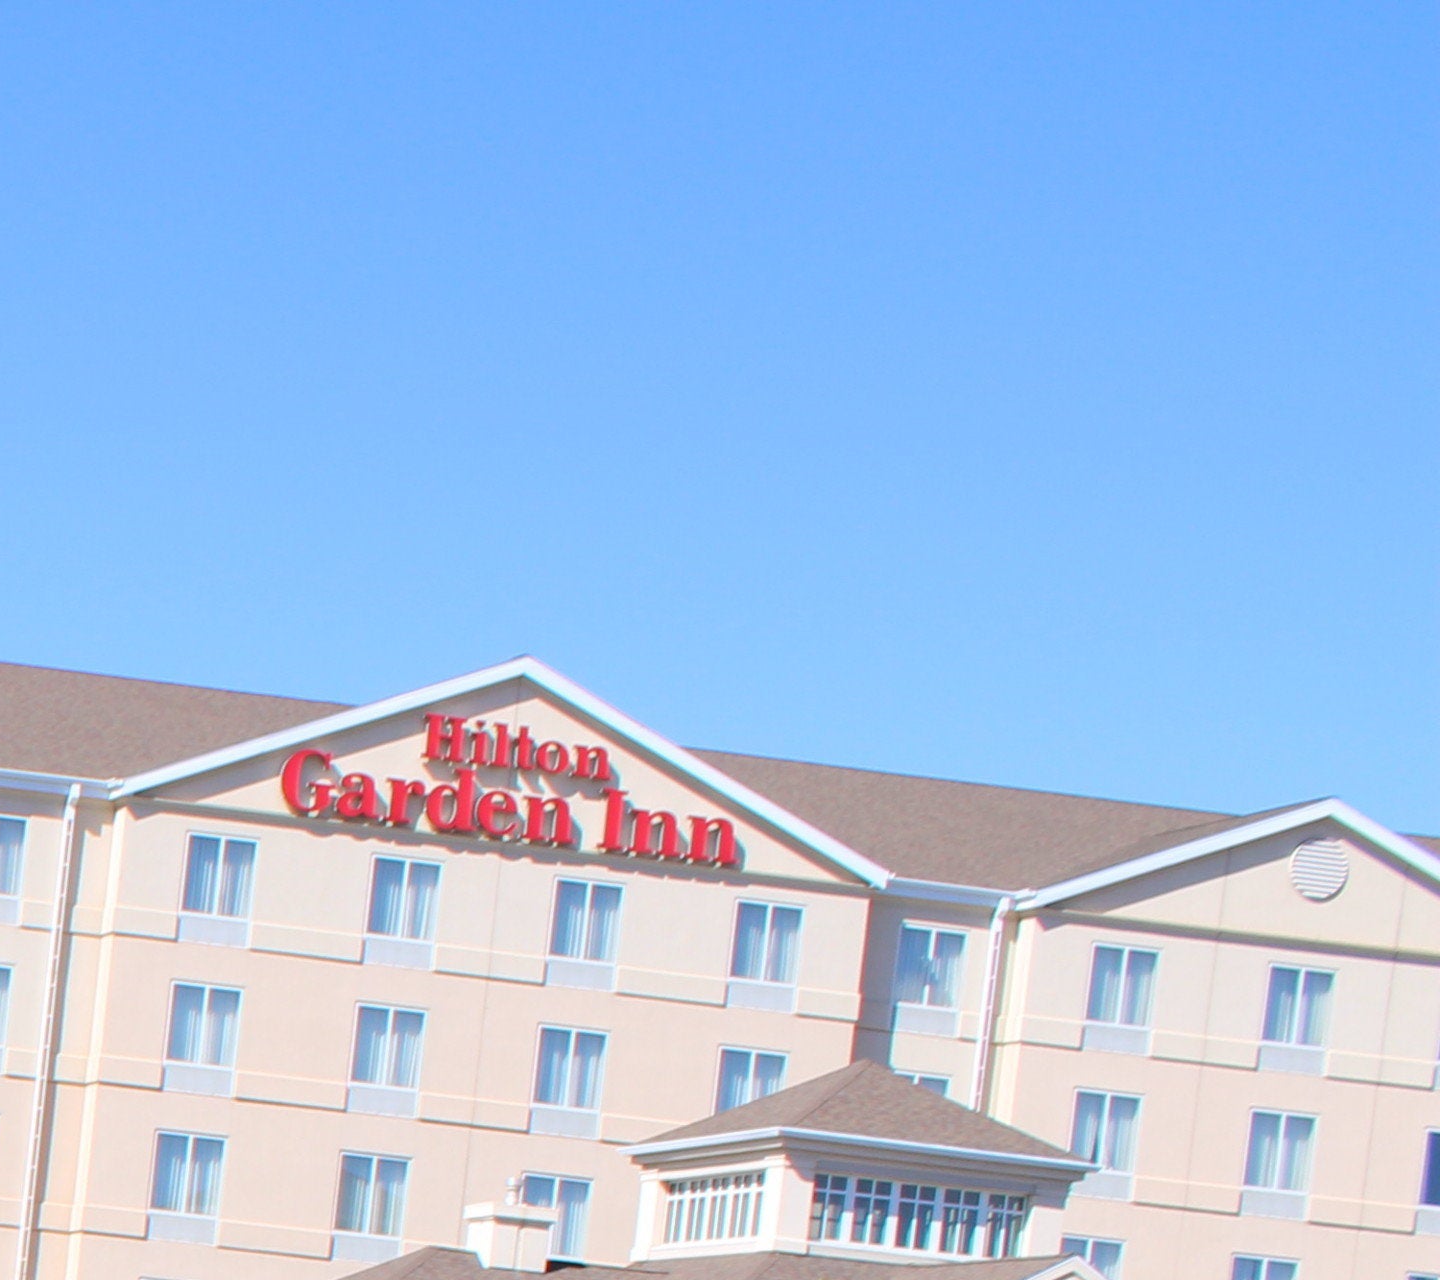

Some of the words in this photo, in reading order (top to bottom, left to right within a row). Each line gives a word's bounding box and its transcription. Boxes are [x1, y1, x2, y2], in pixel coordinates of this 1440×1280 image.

[420, 712, 611, 781] Hilton
[280, 748, 574, 847] Garden
[597, 786, 739, 868] Inn
